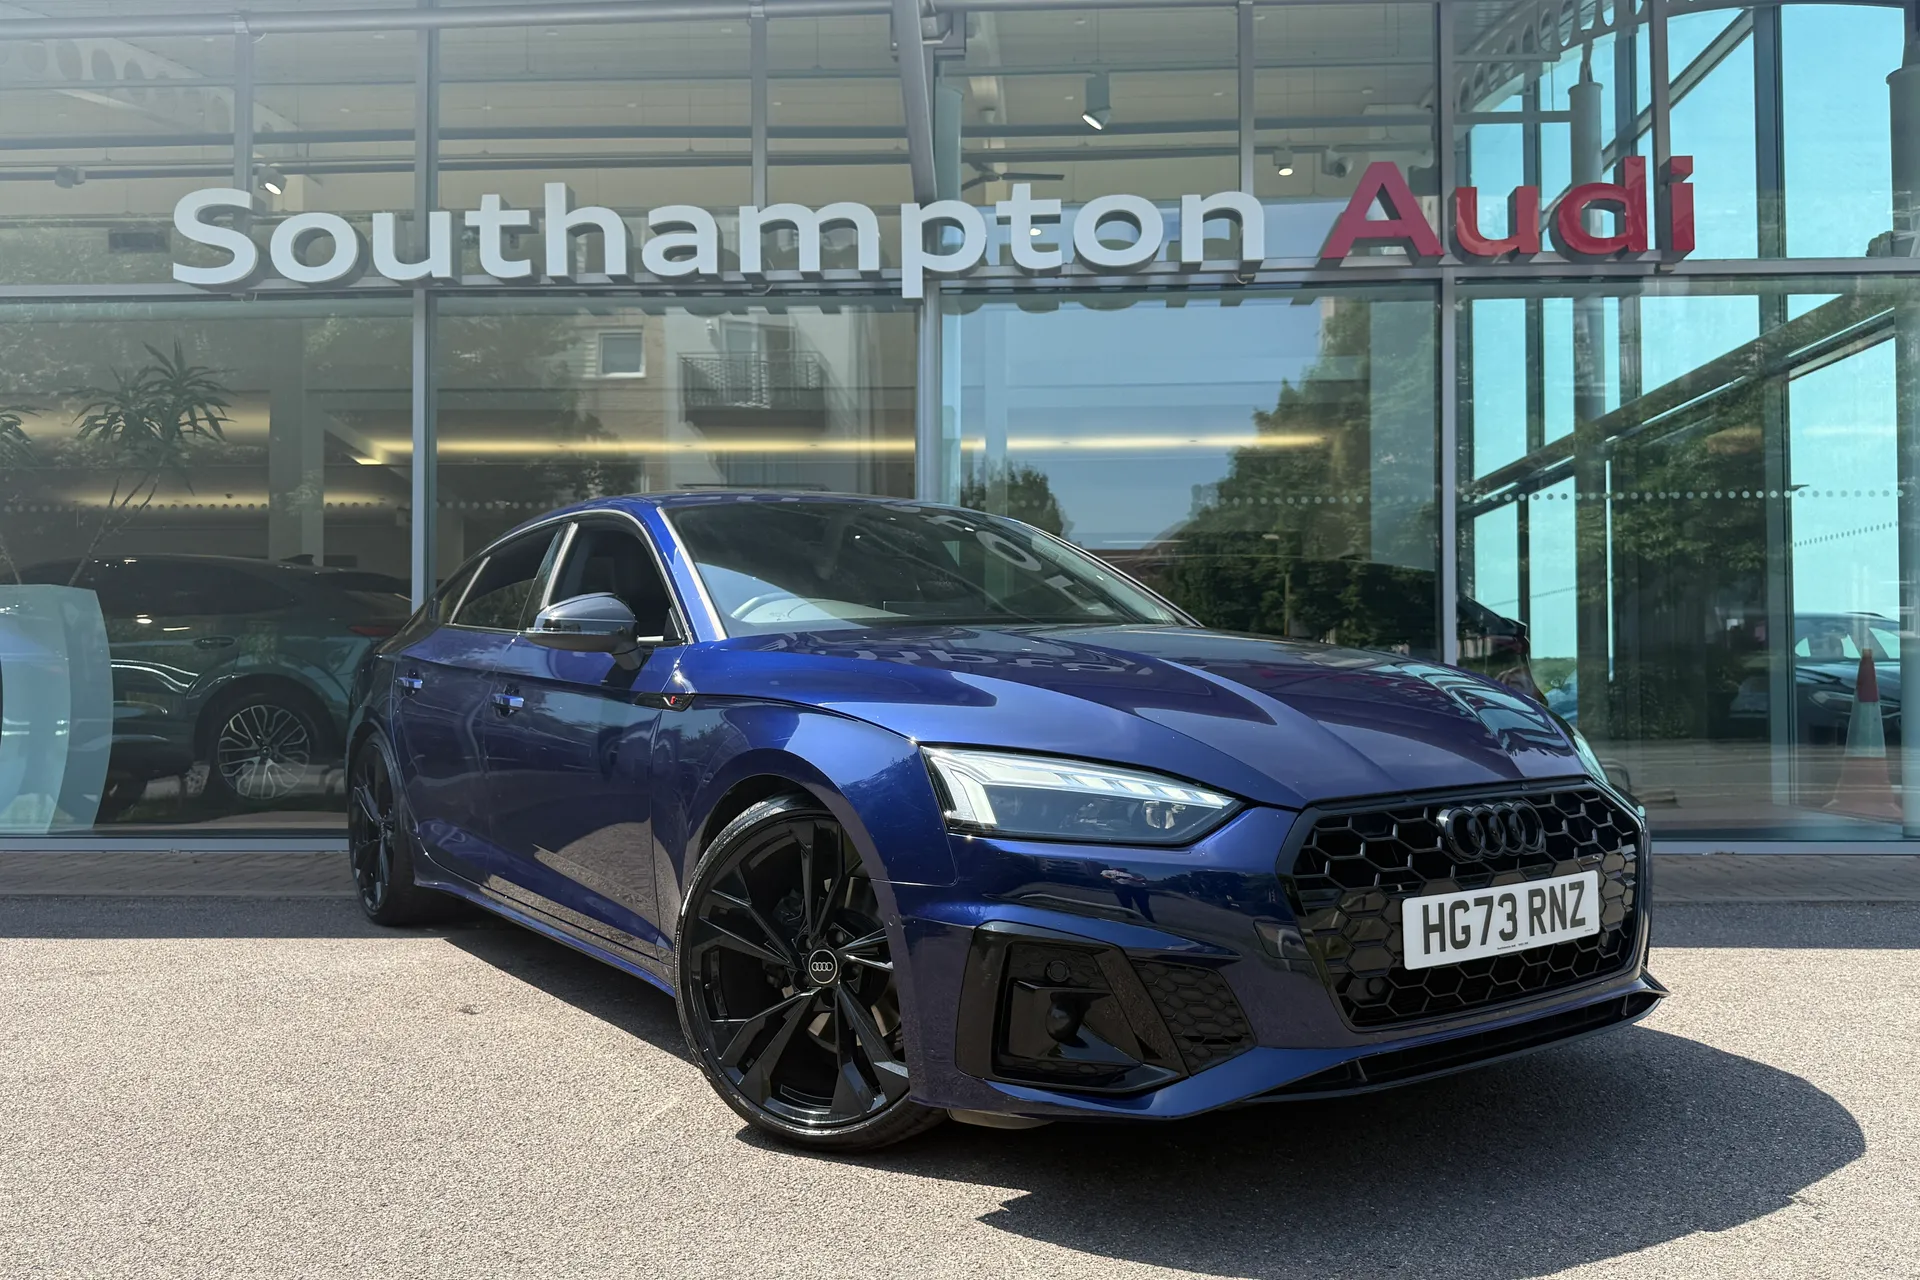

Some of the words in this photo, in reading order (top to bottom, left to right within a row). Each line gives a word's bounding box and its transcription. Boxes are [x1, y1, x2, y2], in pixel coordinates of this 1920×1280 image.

[173, 182, 1265, 298] Southampton
[1321, 155, 1695, 259] Audi
[1422, 891, 1518, 955] HG73
[1527, 880, 1586, 937] RNZ
